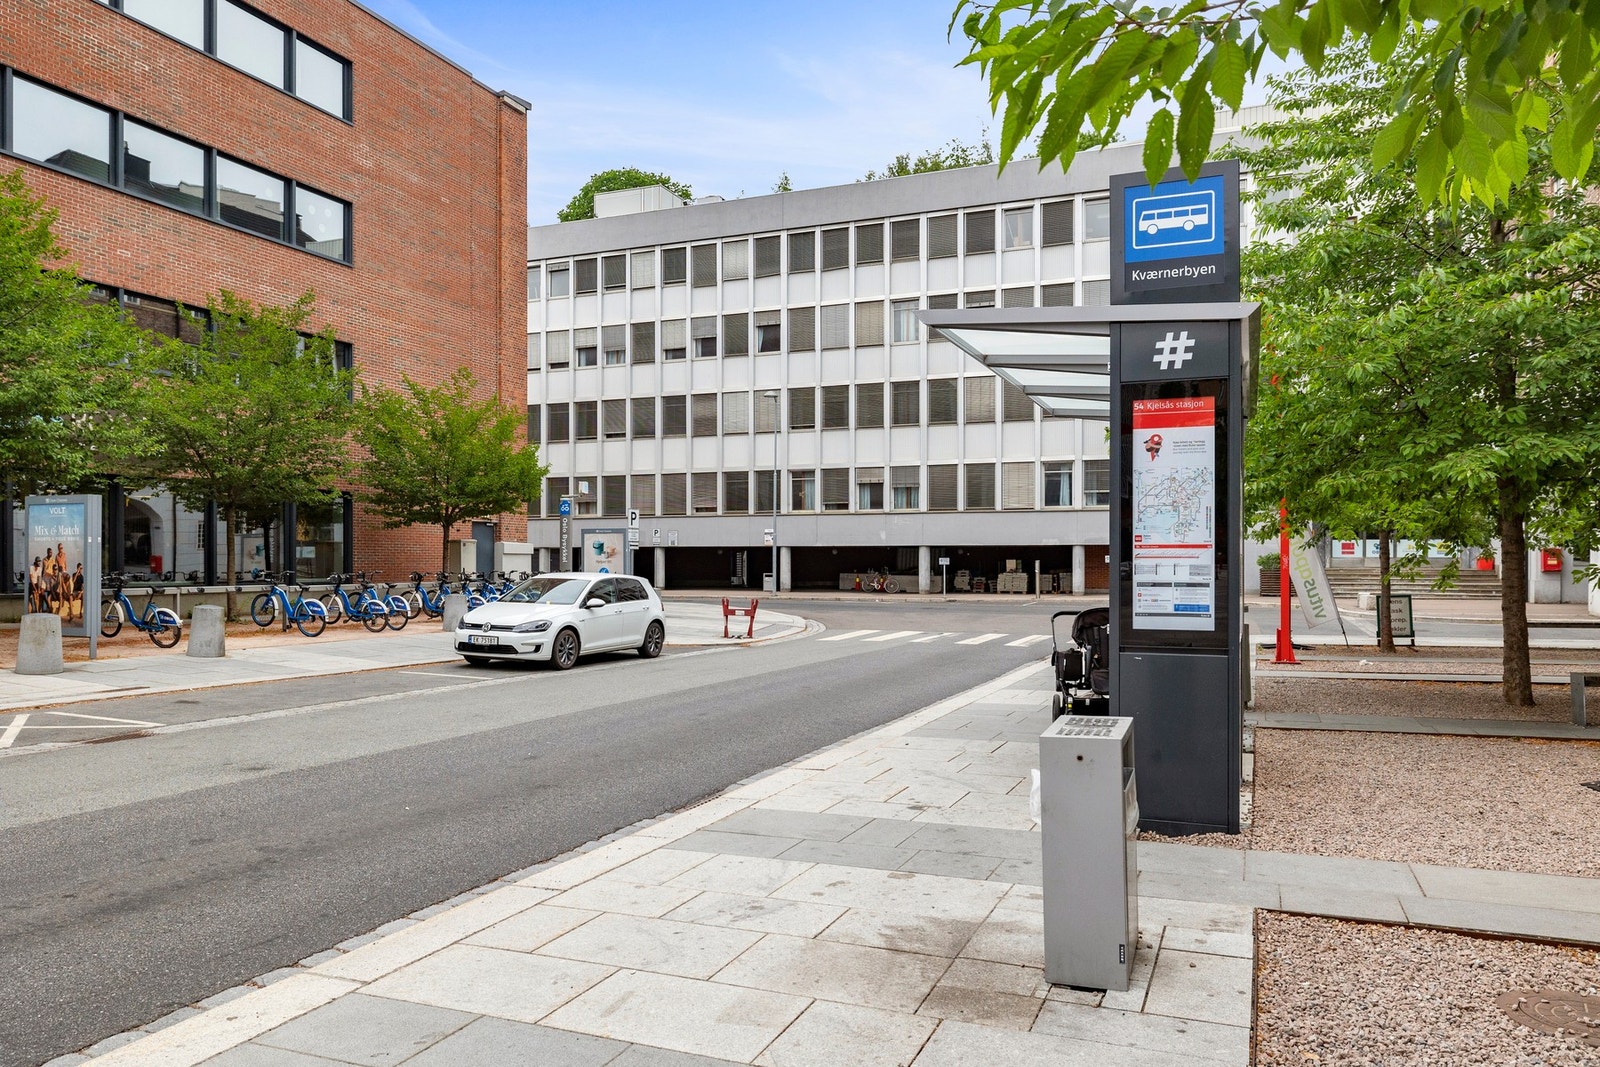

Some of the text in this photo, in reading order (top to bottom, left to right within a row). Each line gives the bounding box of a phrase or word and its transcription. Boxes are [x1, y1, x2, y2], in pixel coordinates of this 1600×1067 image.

[1132, 263, 1216, 282] Kværnerbyen
[1133, 400, 1204, 410] 54 Kjelsås stasjon
[49, 506, 66, 515] VOLT
[630, 511, 637, 526] P
[34, 525, 49, 536] Mix
[58, 524, 80, 536] Match
